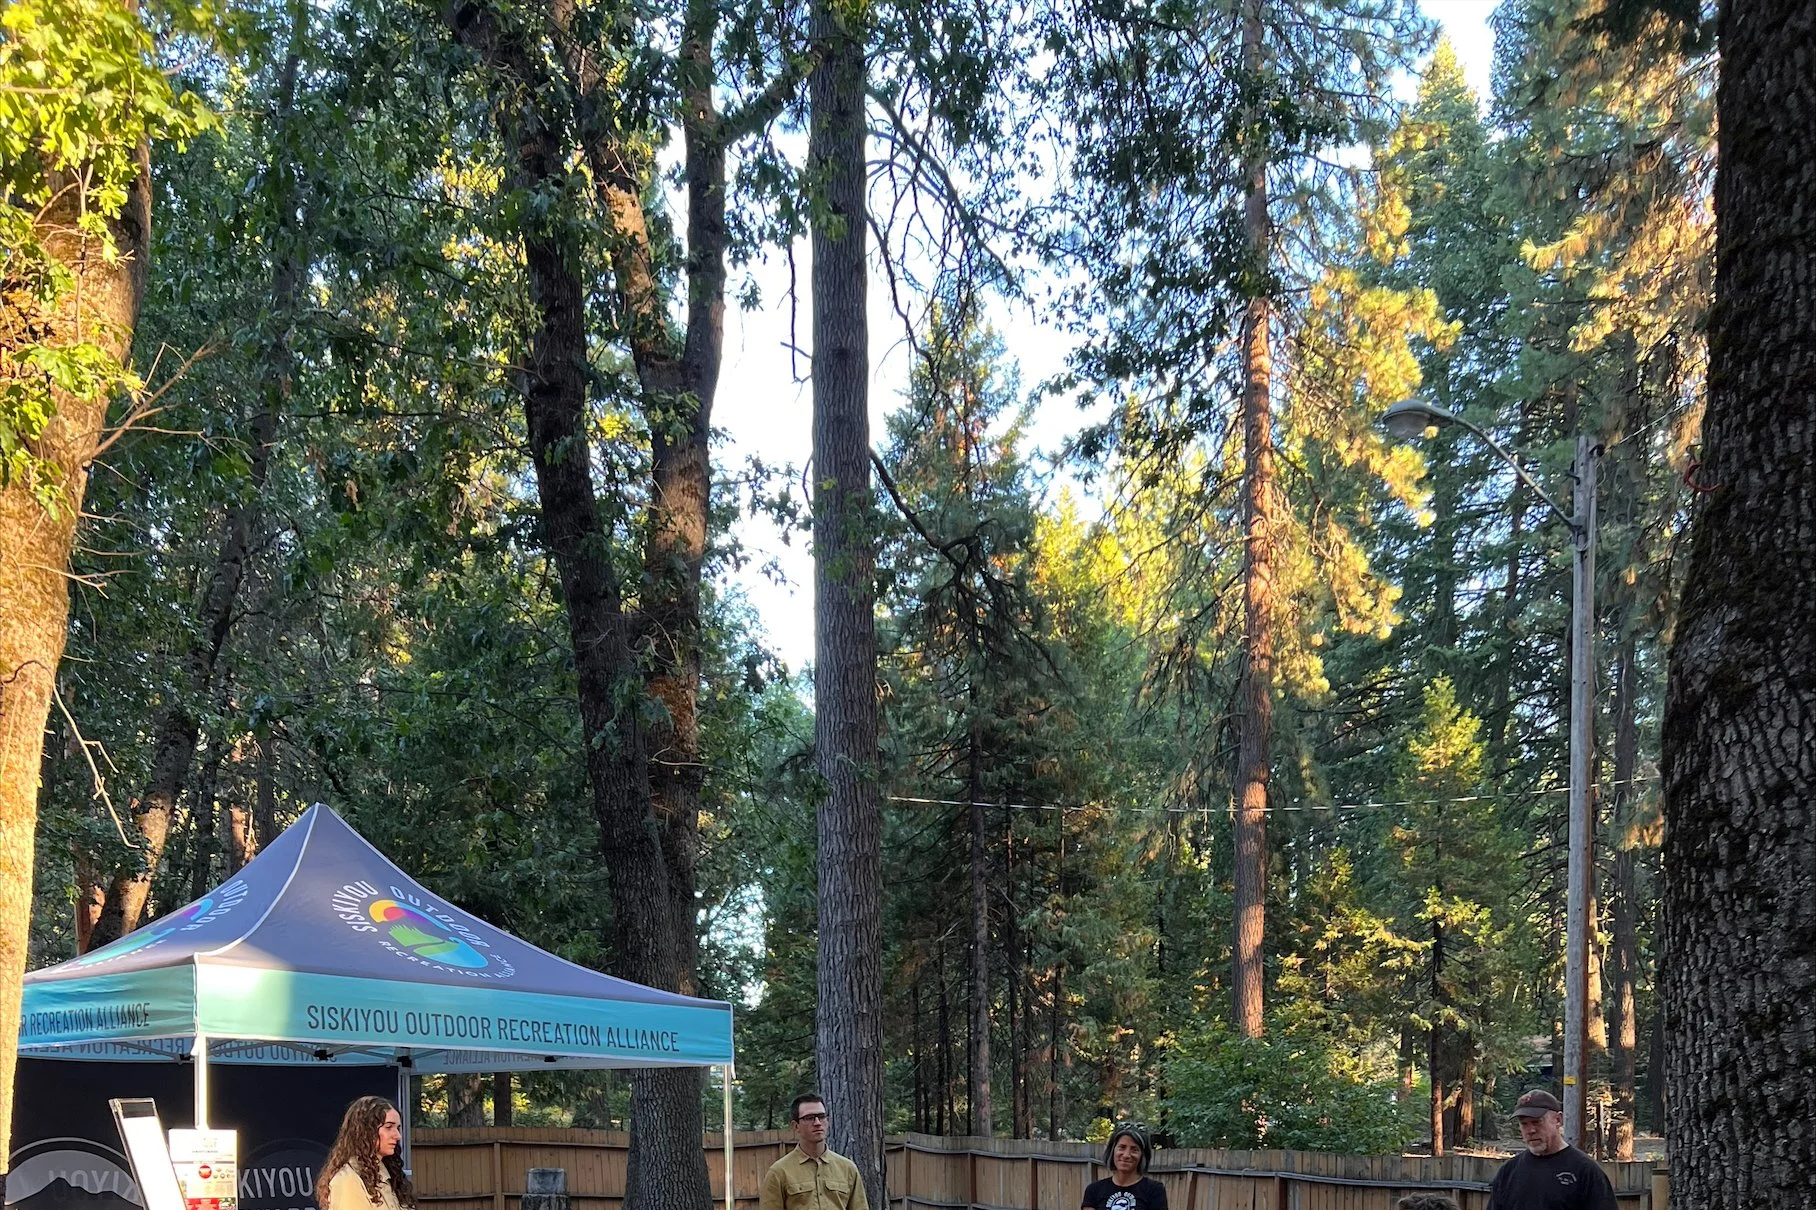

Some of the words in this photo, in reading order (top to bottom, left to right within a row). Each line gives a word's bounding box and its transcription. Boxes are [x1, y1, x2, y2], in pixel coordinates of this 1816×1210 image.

[332, 880, 379, 933] SISKIYOU
[389, 885, 490, 948] OUTDOOR
[378, 940, 492, 978] RECREATION
[30, 1008, 95, 1035] RECREATION
[96, 1002, 151, 1030] ALLIANCE
[307, 1005, 399, 1034] SISKIYOU
[405, 1011, 492, 1040] OUTDOOR
[498, 1018, 602, 1047] RECREATION
[606, 1025, 681, 1053] ALLIANCE
